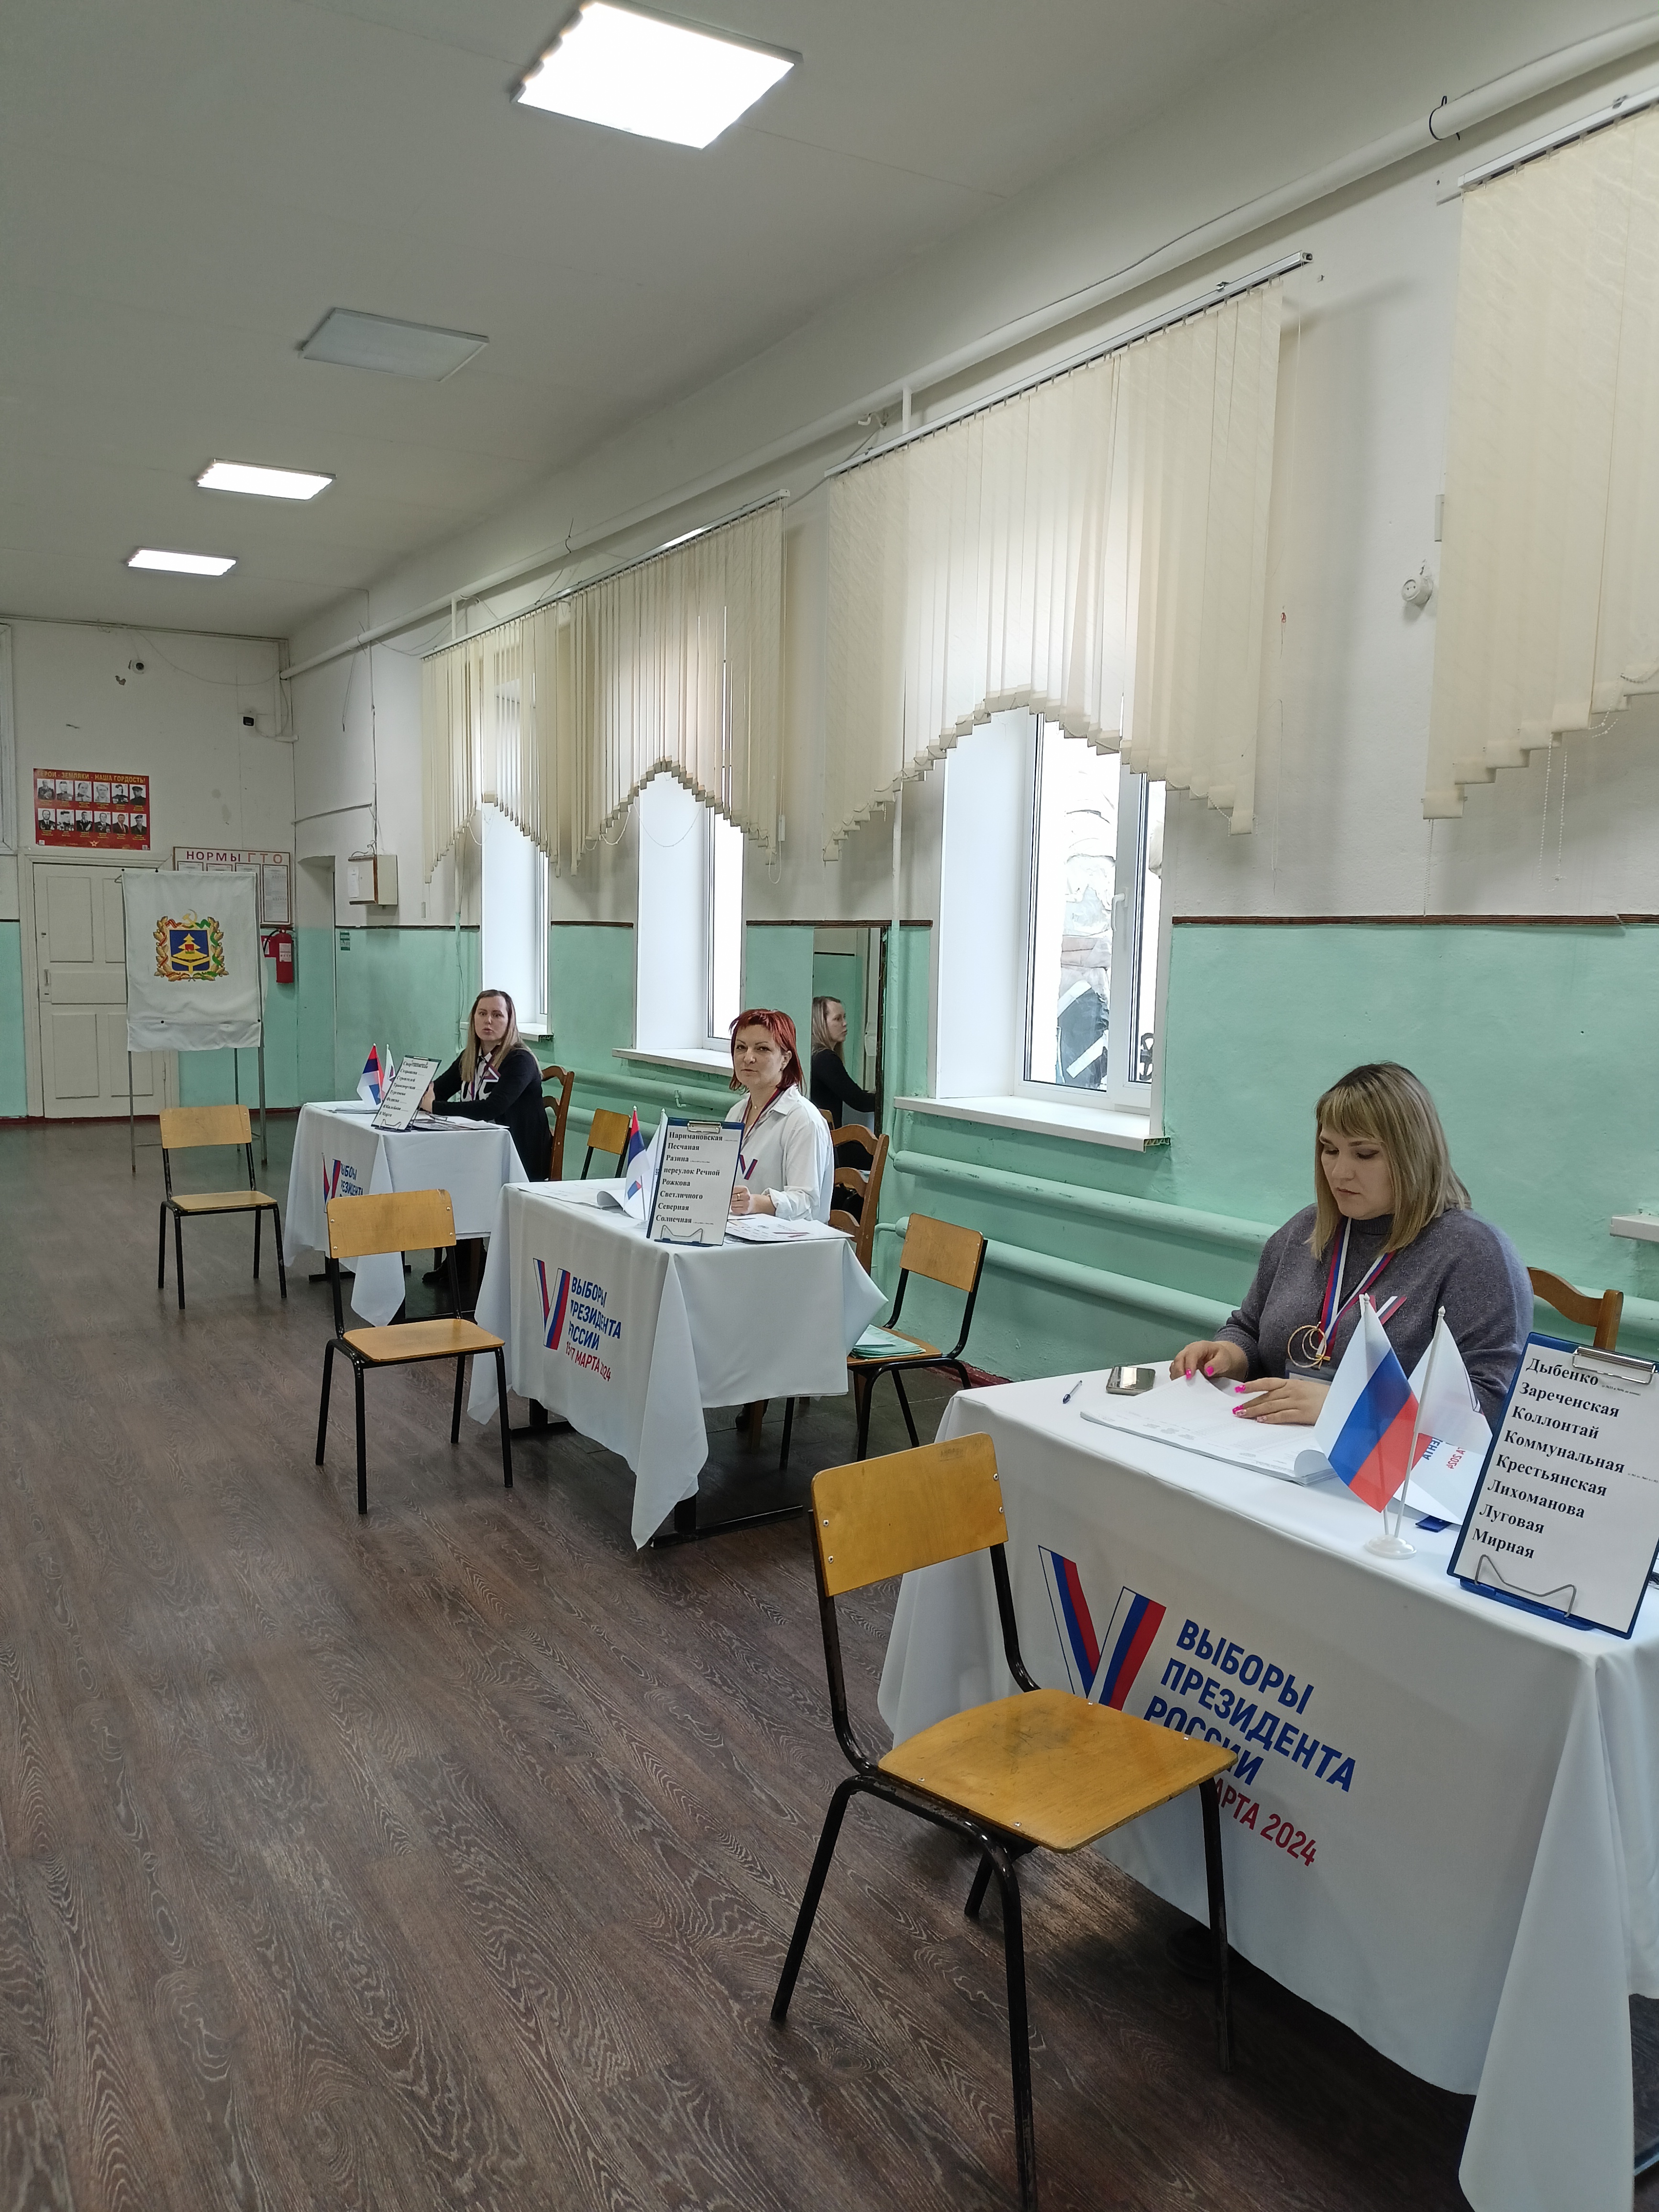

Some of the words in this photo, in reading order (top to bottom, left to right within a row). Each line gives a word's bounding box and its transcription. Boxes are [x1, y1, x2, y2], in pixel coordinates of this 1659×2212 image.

[187, 851, 241, 862] НОРМЫ
[248, 852, 283, 864] ГТО
[669, 1132, 723, 1141] Наримановская
[660, 1191, 703, 1199] Светличного
[662, 1178, 690, 1186] Рожкова
[656, 1215, 692, 1223] Солнечная
[658, 1203, 689, 1211] Северная
[571, 1276, 608, 1307] ВЫБОРЫ
[575, 1350, 600, 1372] МАРТА
[1526, 1358, 1599, 1385] Дыбенко
[1519, 1382, 1620, 1418] Зареченская
[1511, 1405, 1599, 1439] Коллонтай
[1504, 1430, 1625, 1473] Коммунальная
[1496, 1454, 1608, 1496] Крестьянская
[1487, 1479, 1585, 1518] Лихоманова
[1479, 1504, 1545, 1534] Луговая
[1471, 1528, 1535, 1559] Мирная
[1176, 1619, 1315, 1715] ВЫБОРЫ
[1161, 1658, 1356, 1792] ПРЕЗИДЕНТА
[1215, 1778, 1260, 1830] АРТА
[1260, 1814, 1317, 1867] 2024
